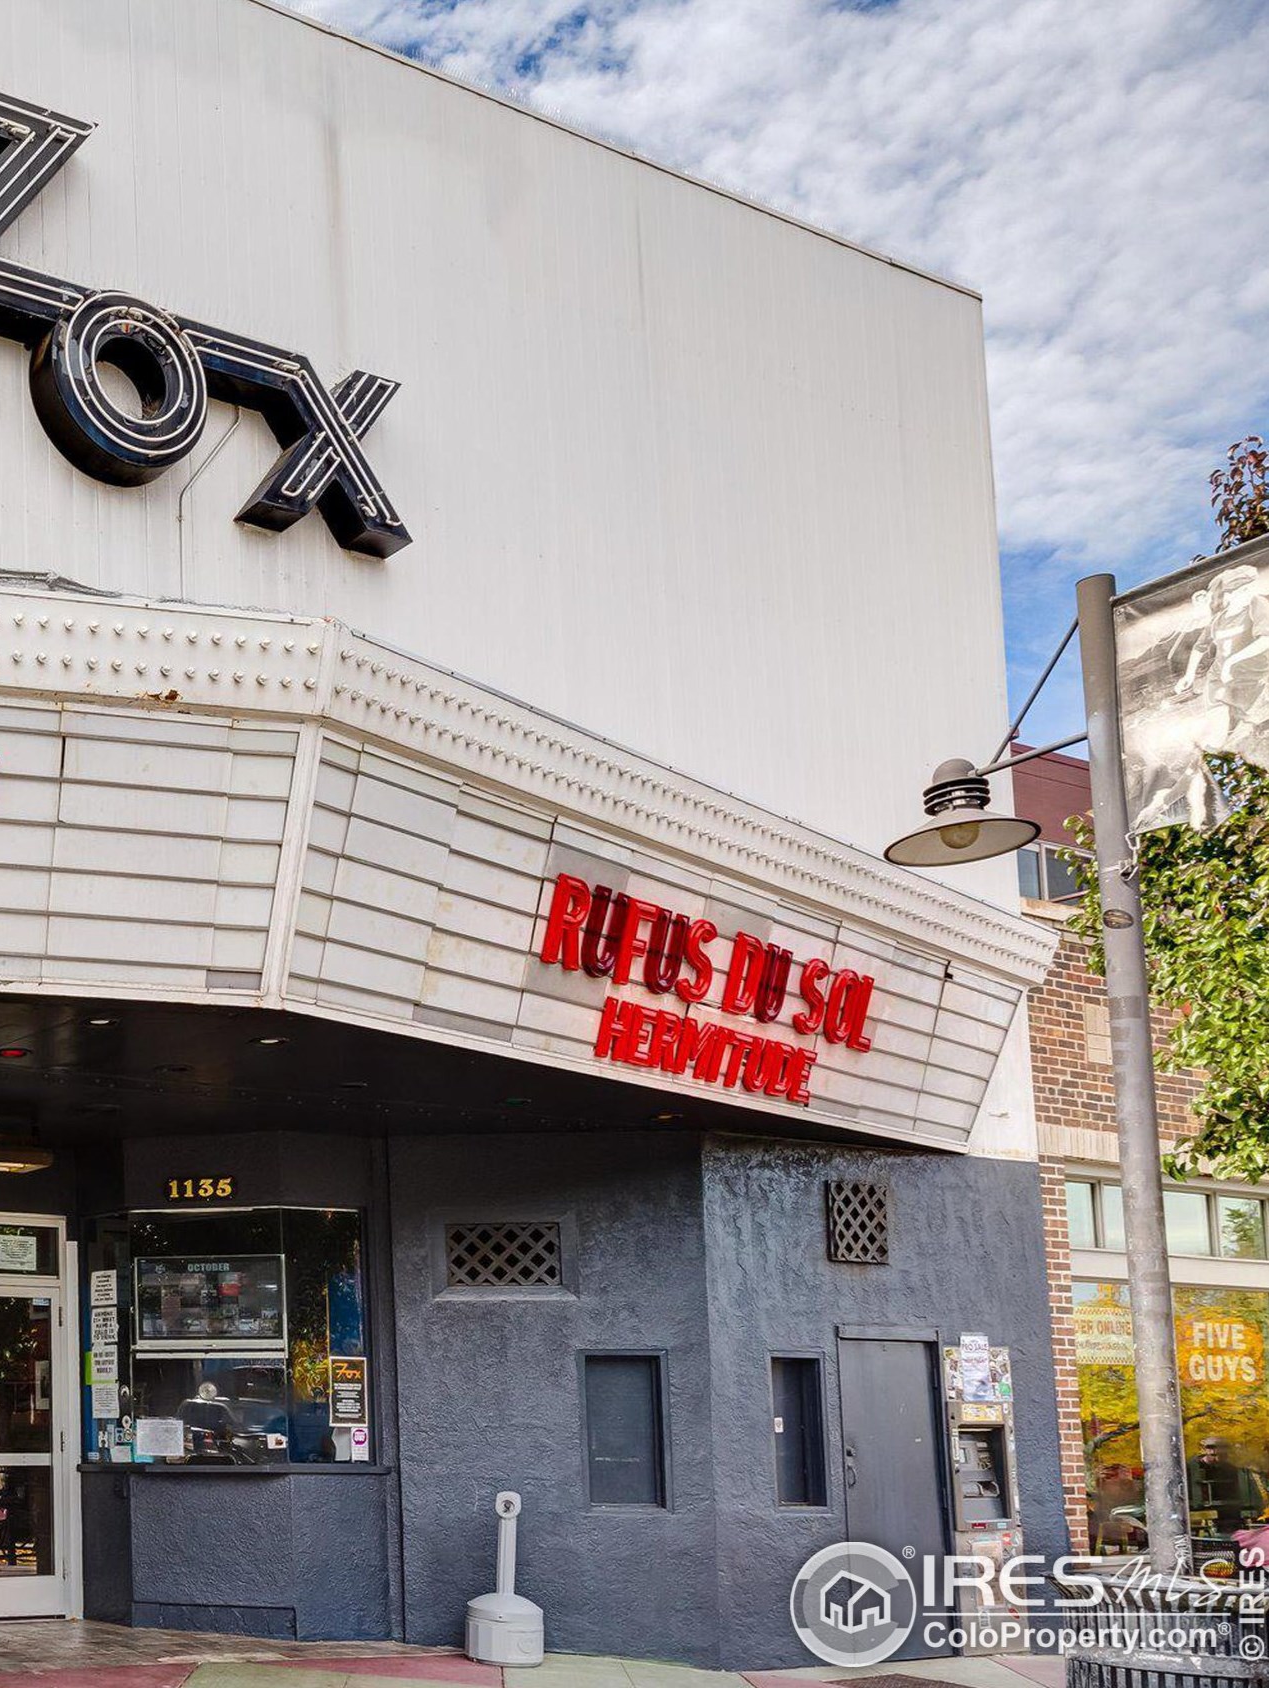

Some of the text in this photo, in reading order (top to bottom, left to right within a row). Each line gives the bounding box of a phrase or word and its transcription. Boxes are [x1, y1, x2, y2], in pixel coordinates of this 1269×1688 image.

[540, 873, 875, 1053] RUFUS DU SOL
[593, 996, 818, 1107] HERMITUDE
[169, 1177, 232, 1198] 1135
[187, 1262, 231, 1272] OCTOBER
[1191, 1321, 1247, 1350] FIVE
[1188, 1355, 1257, 1385] GUYS
